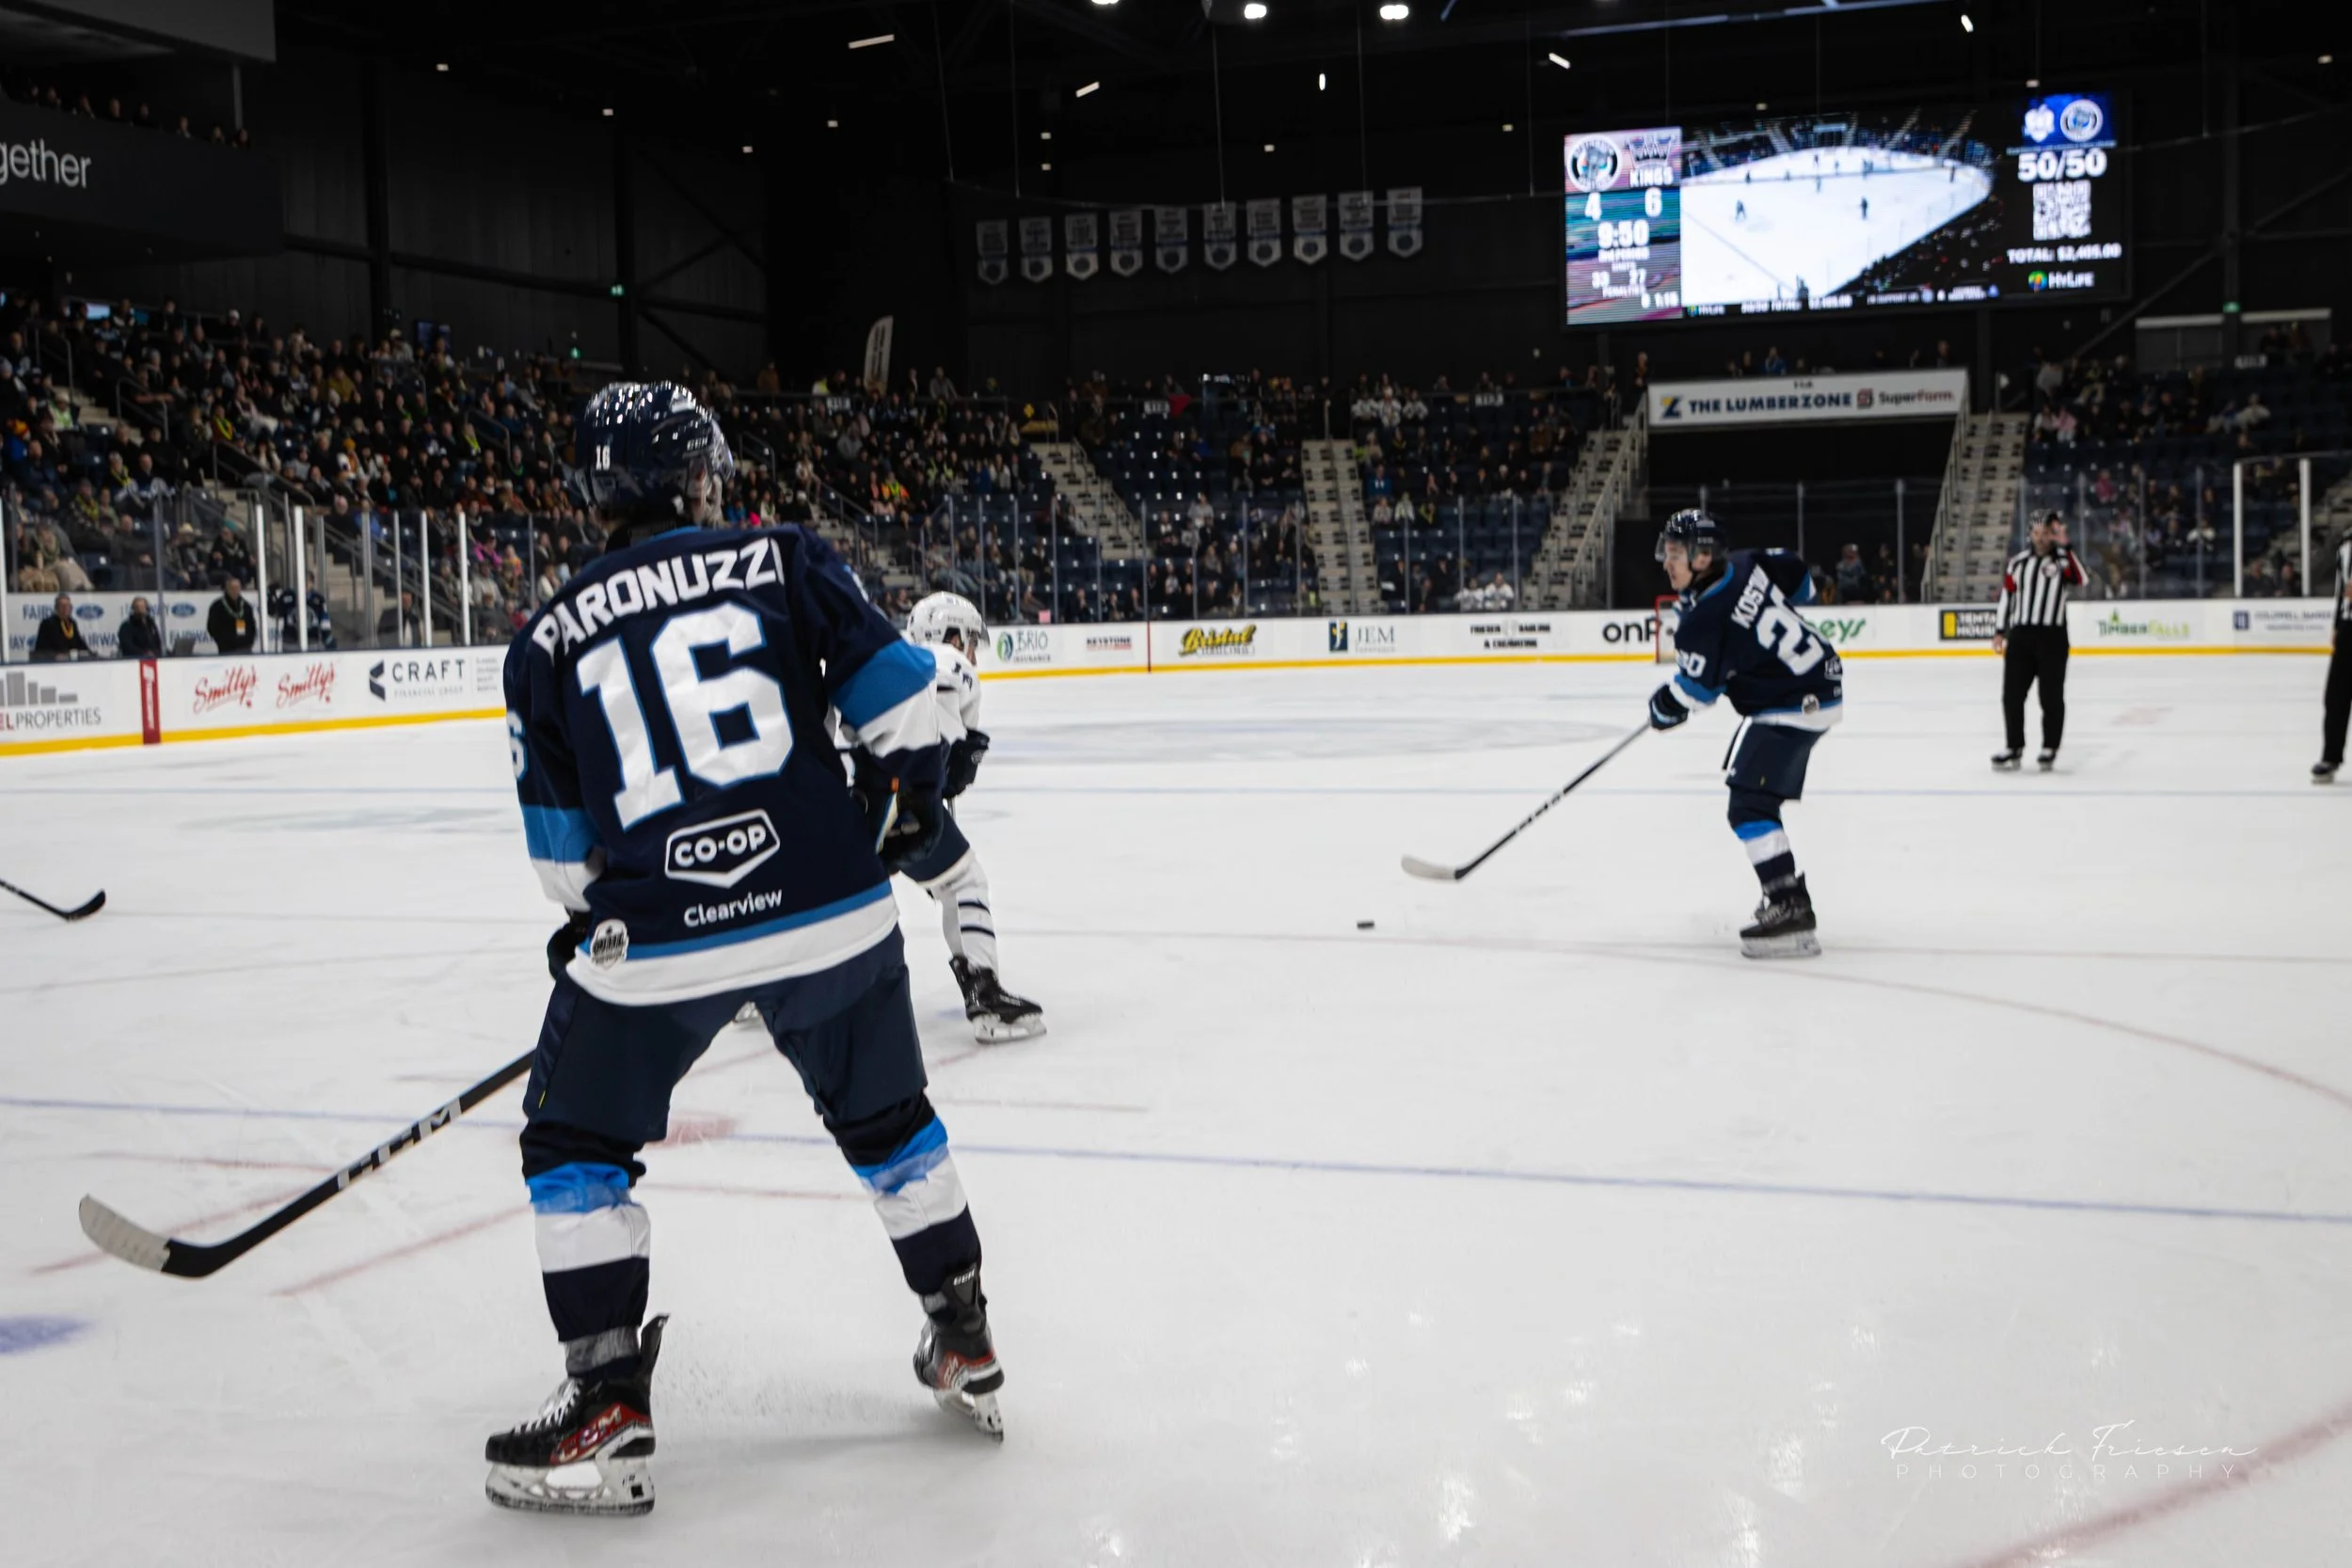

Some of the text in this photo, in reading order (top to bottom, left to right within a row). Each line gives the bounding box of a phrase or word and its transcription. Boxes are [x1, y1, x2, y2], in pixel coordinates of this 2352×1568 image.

[1629, 166, 1673, 187] KINGS
[2018, 148, 2107, 182] 50/50
[1585, 192, 1601, 221] 4
[1645, 188, 1662, 216] 6
[2007, 247, 2054, 263] TOTAL:
[1689, 399, 1721, 414] THE
[1726, 390, 1851, 413] LUMBERZONE
[532, 537, 785, 666] PARONUZZI
[1016, 630, 1048, 651] BRIO
[1358, 626, 1394, 643] JEM
[392, 659, 466, 683] CRAFT
[576, 601, 795, 833] 16
[674, 825, 768, 868] CO-OP
[684, 889, 784, 928] Clearview
